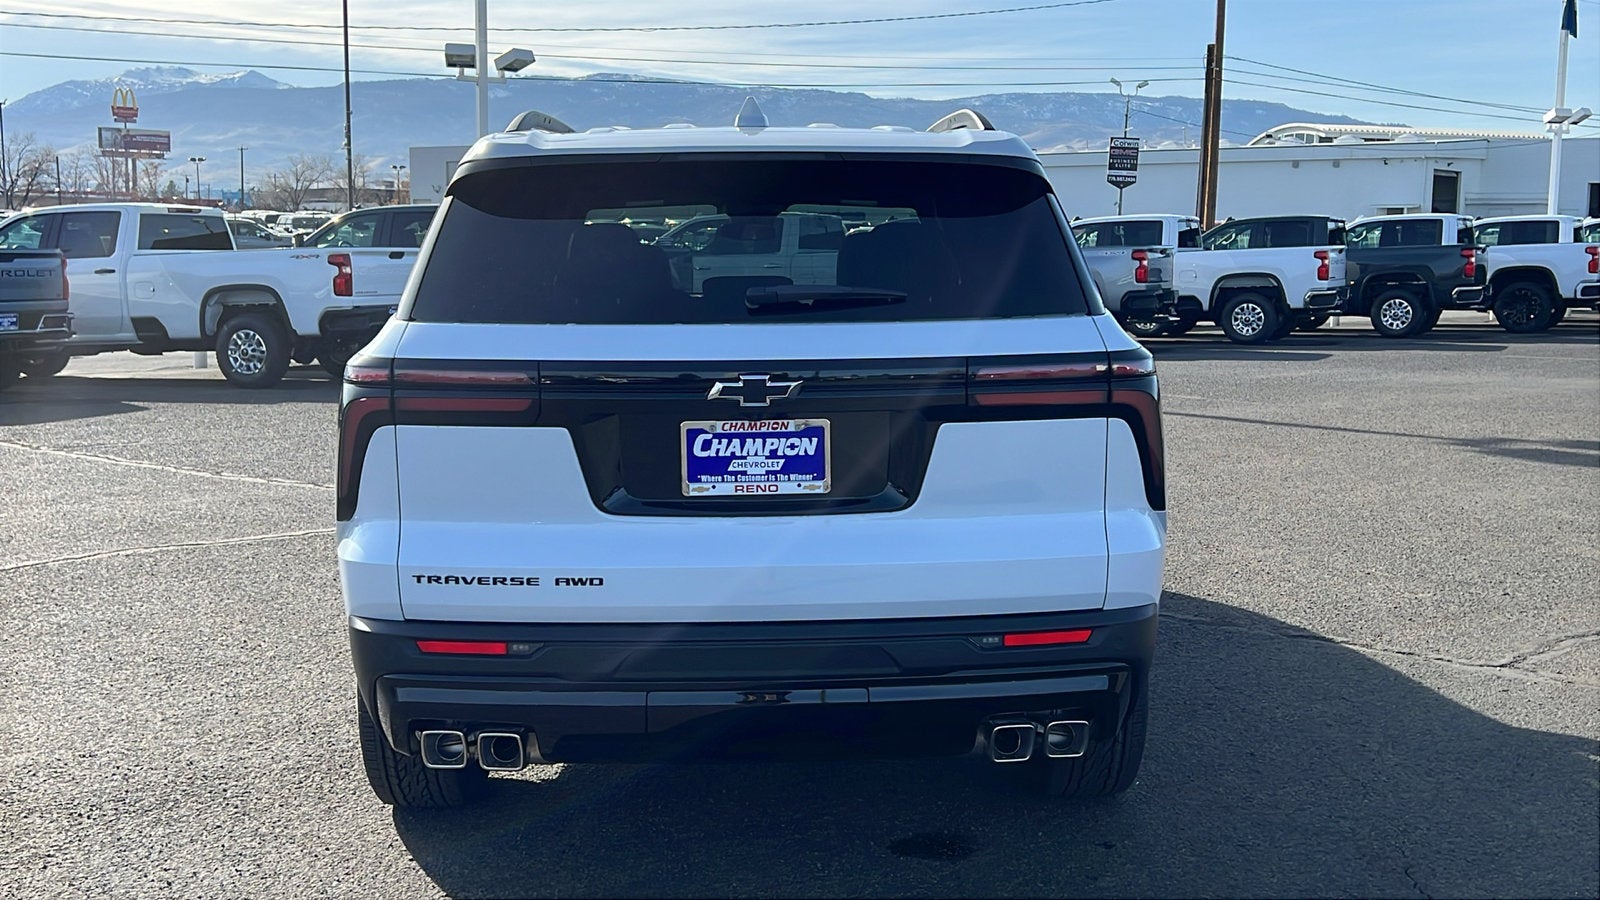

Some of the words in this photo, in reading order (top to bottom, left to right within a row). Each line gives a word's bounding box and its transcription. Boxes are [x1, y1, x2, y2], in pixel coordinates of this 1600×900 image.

[0, 269, 56, 278] ROLET
[721, 421, 790, 432] CHAMPION
[692, 433, 818, 457] CHAMPION
[731, 460, 781, 469] CHEVROLET
[723, 474, 735, 482] The
[737, 474, 768, 482] Customer
[777, 473, 788, 481] The
[734, 484, 779, 493] RENO
[412, 575, 540, 586] TRAVERSE
[554, 577, 604, 587] AWD
